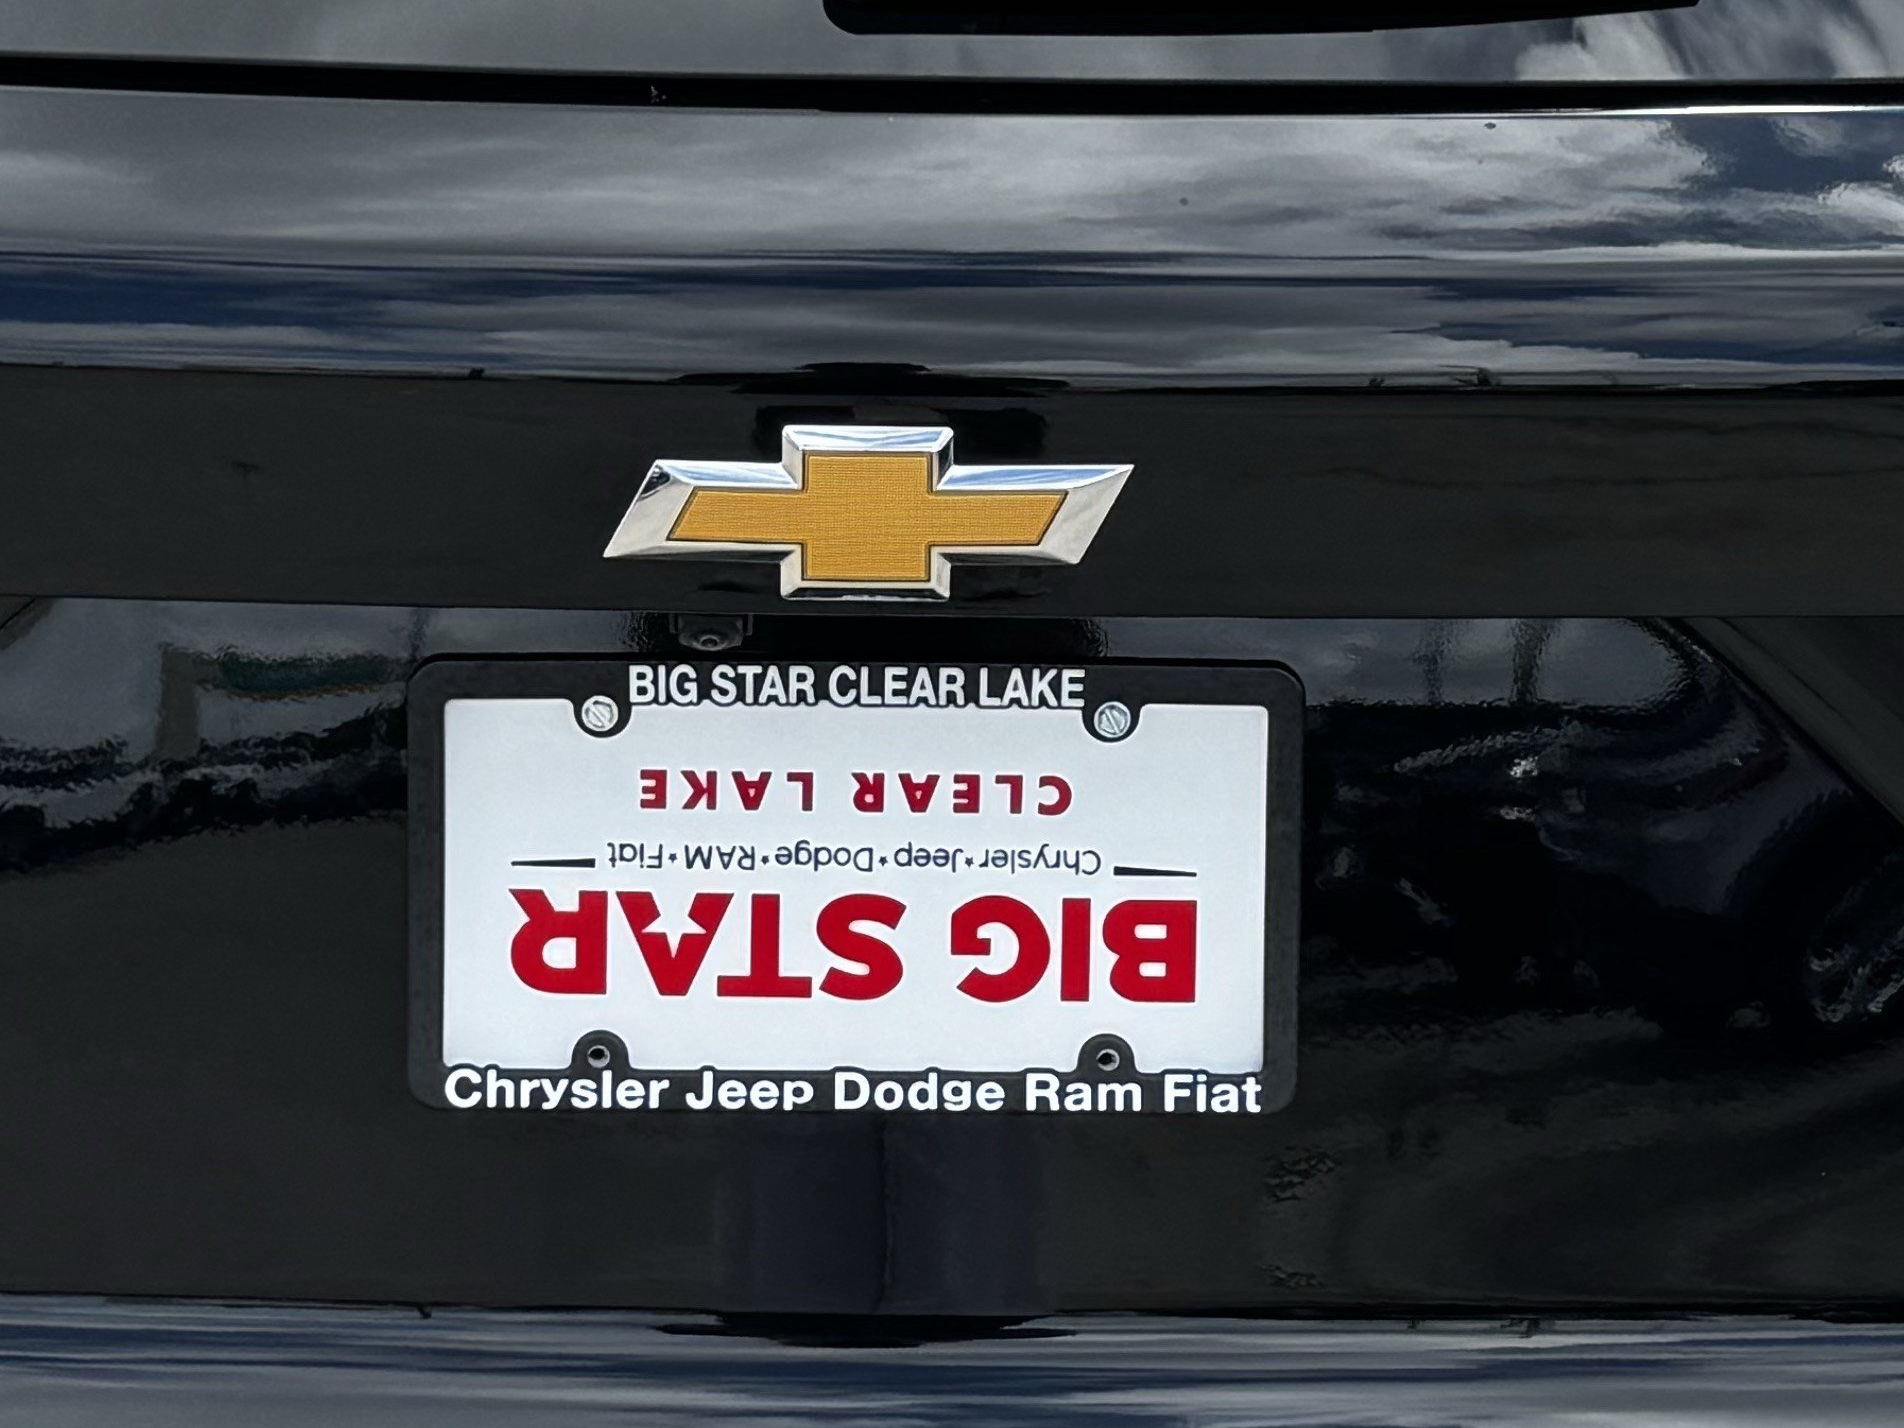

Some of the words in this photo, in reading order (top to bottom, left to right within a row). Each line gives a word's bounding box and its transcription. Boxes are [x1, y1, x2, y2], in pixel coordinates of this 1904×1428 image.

[628, 663, 699, 706] BIG
[709, 663, 817, 707] STAR
[827, 664, 966, 708] CLEAR
[978, 666, 1087, 710] LAKE
[641, 769, 814, 811] LAKE
[852, 772, 1072, 815] CLEAR
[509, 889, 905, 1000] STAR
[951, 894, 1197, 1003] BIG
[443, 1067, 671, 1111] Chrysler
[684, 1069, 815, 1112] Jeep
[832, 1071, 1007, 1113] Dodge
[1024, 1072, 1143, 1113] Ram
[1162, 1073, 1263, 1114] Fiat
